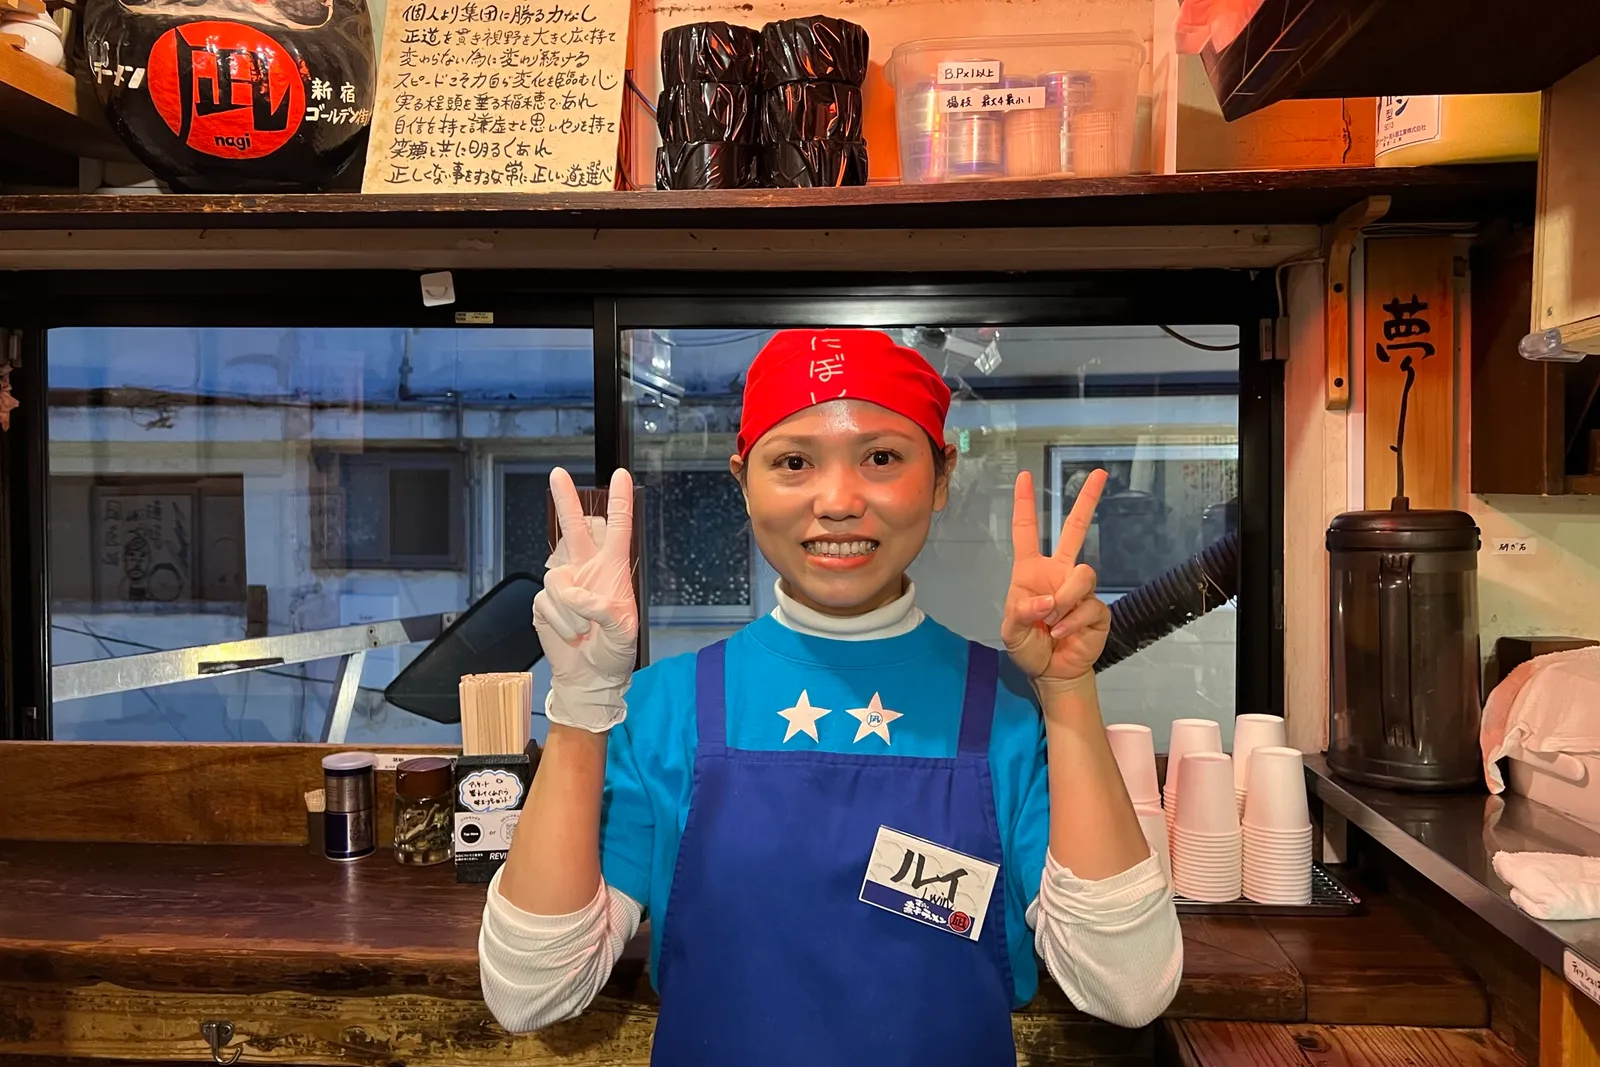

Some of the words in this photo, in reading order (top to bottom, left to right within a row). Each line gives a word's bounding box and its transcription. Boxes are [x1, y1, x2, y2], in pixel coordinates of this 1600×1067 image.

[311, 77, 356, 103] 新宿
[213, 133, 251, 150] nagi
[890, 848, 968, 904] ルイ
